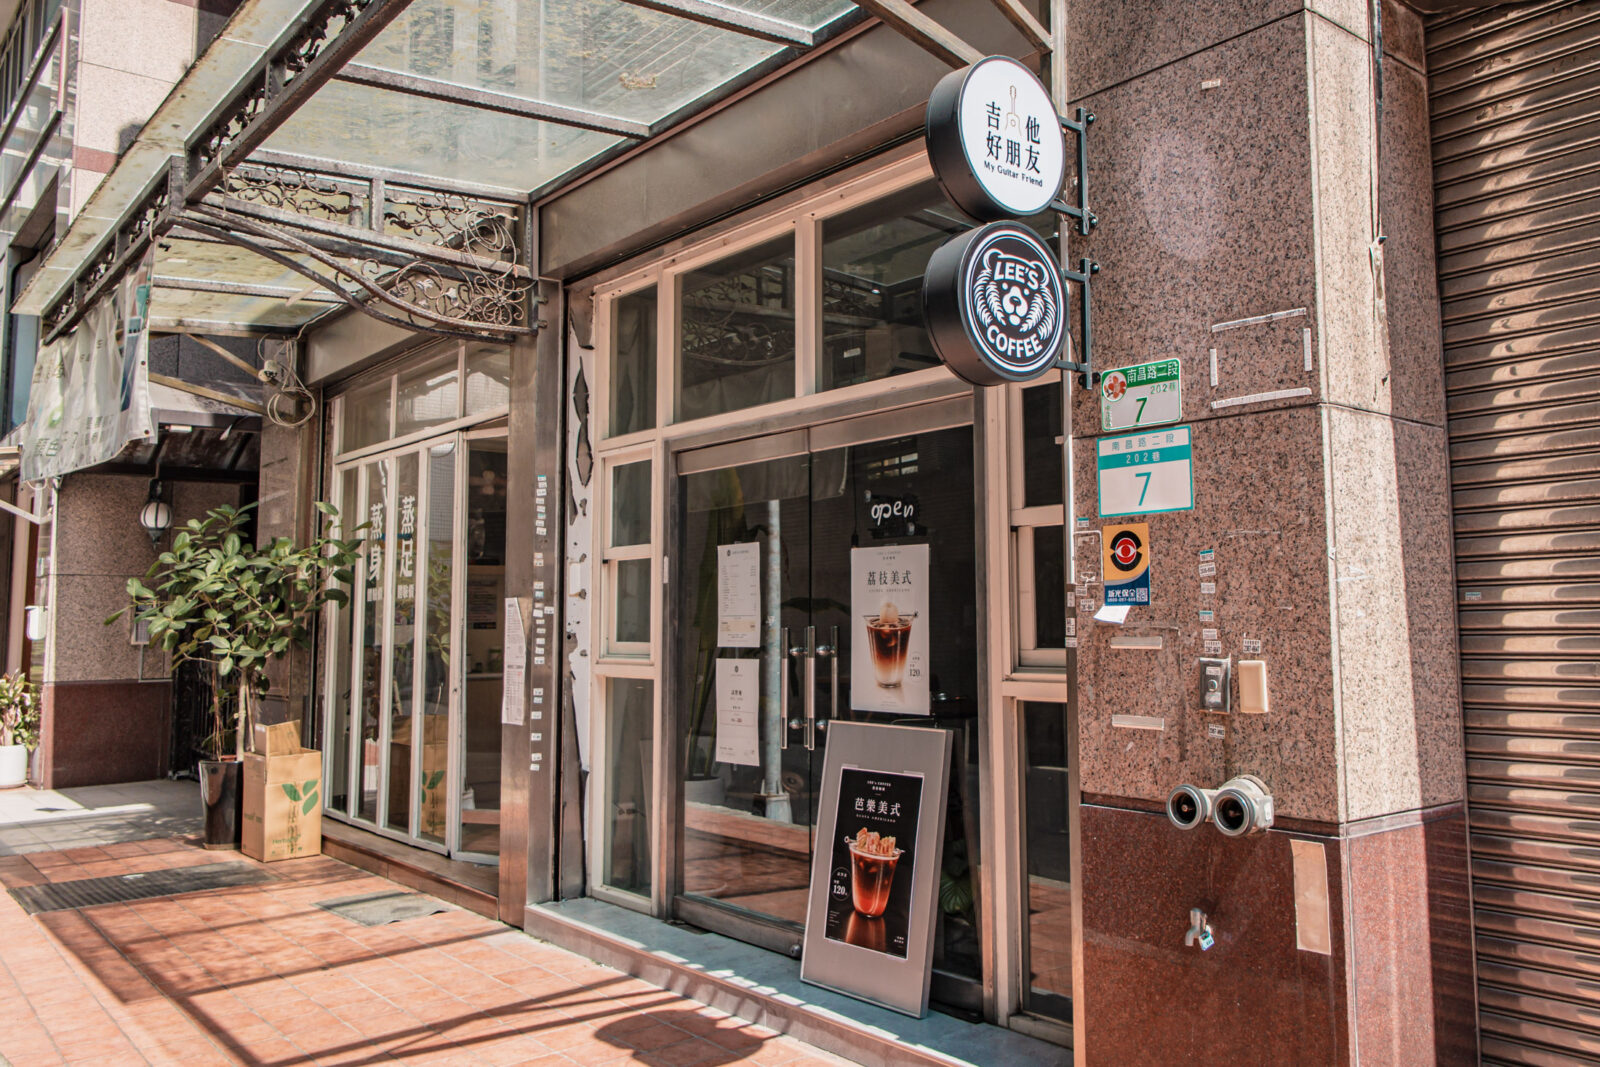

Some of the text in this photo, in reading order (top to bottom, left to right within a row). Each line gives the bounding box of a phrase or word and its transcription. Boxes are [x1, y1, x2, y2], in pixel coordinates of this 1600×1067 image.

[986, 101, 1041, 145] 吉他
[986, 131, 1041, 174] 好朋友
[984, 160, 1043, 188] My Guitar Friend
[993, 261, 1039, 290] LEE'S
[986, 324, 1043, 358] COFFEE
[1127, 361, 1179, 383] 南昌路二段
[1136, 397, 1148, 423] 7
[1112, 433, 1174, 451] 南昌路二段
[1135, 471, 1152, 506] 7
[871, 500, 914, 526] open
[400, 496, 415, 577] 蒸足
[867, 570, 912, 586] 荔枝美式
[855, 797, 901, 817] 芭樂美式
[833, 884, 846, 896] 120
